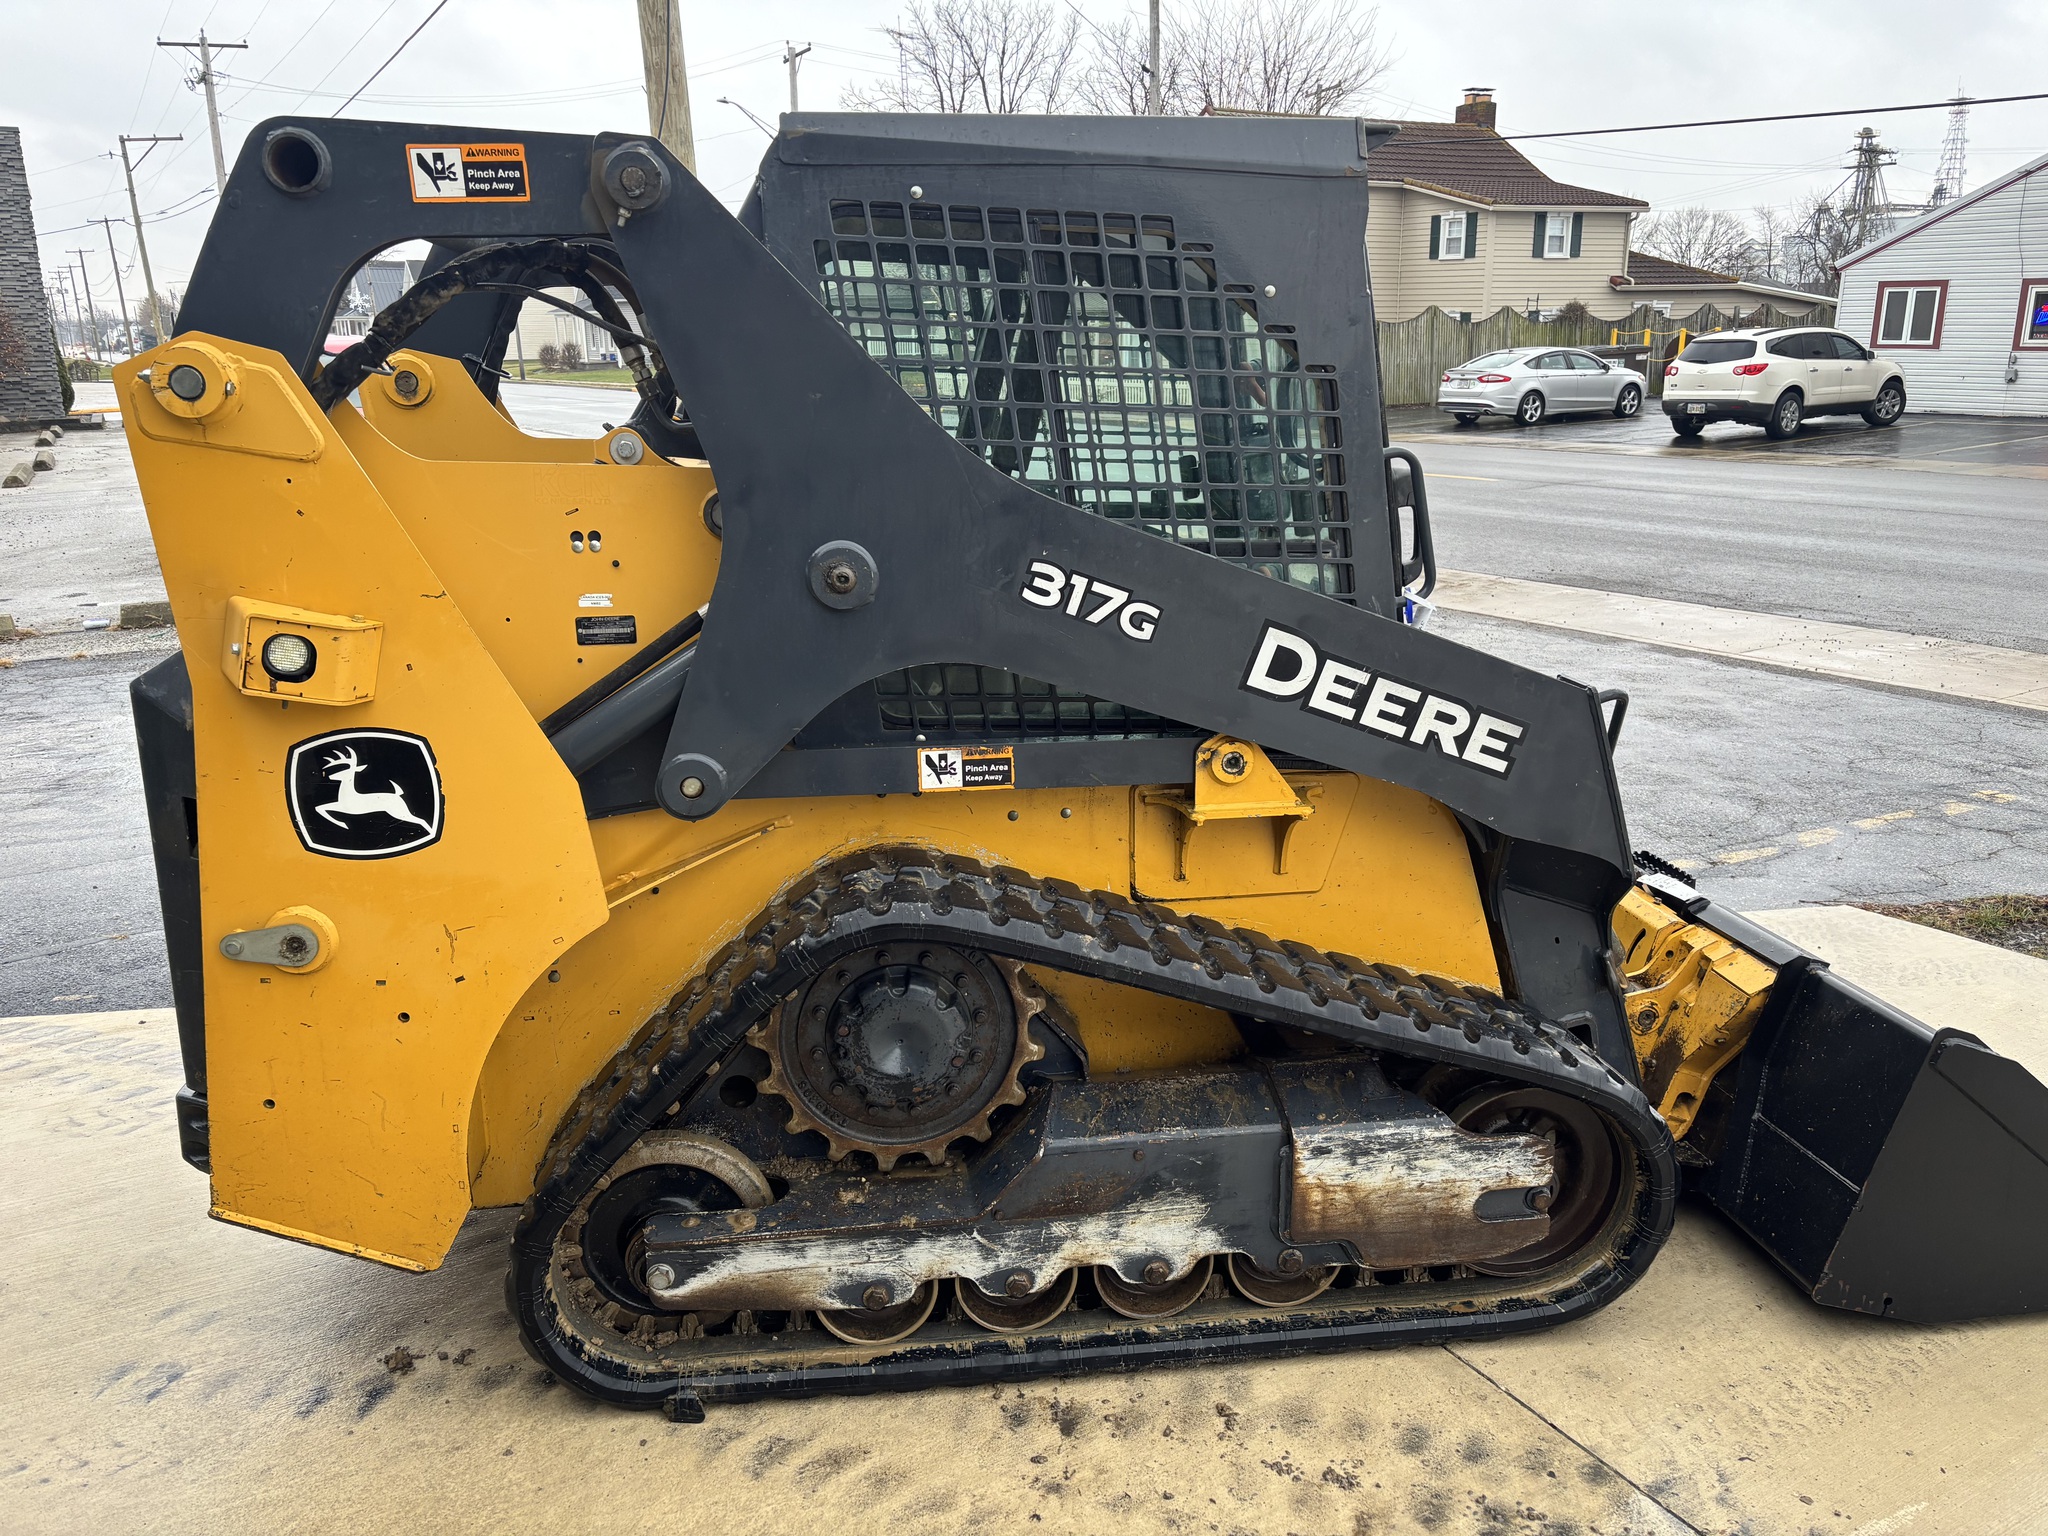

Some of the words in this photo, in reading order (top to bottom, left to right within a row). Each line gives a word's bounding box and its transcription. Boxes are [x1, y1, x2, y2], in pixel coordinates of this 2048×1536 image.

[475, 148, 520, 157] WARNING
[467, 169, 496, 178] Pinch
[497, 168, 521, 178] Area
[468, 182, 491, 191] Keep
[491, 181, 515, 191] Away
[1021, 561, 1161, 641] 317G
[1246, 626, 1524, 773] DEERE
[965, 765, 989, 773] Pinch
[989, 764, 1009, 772] Area
